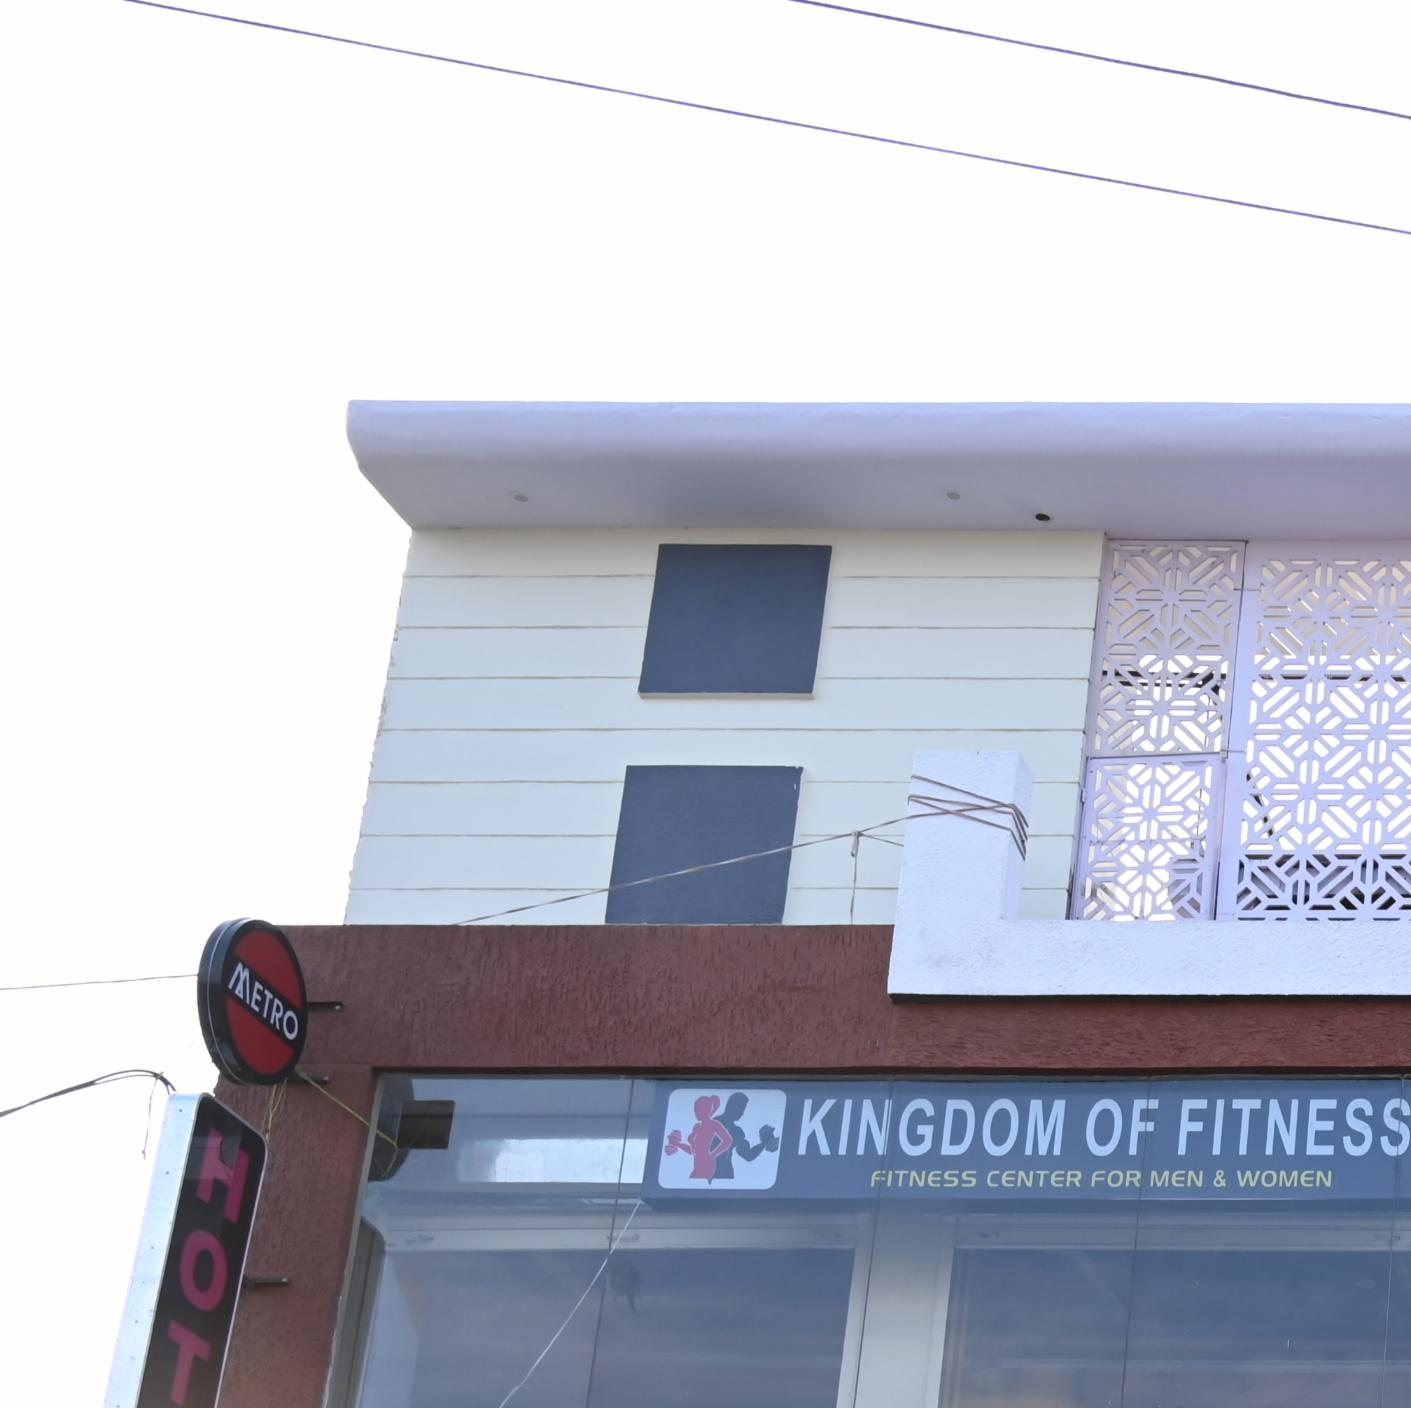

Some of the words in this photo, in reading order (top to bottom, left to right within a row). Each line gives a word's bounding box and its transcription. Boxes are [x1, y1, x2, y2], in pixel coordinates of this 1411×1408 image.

[228, 961, 299, 1042] METRO
[797, 1097, 1066, 1157] KINGDOM
[1085, 1097, 1157, 1157] OF
[1177, 1097, 1411, 1157] FITNESS
[870, 1170, 978, 1189] FITNESS
[986, 1170, 1082, 1189] CENTER
[1091, 1170, 1143, 1188] FOR
[1149, 1170, 1207, 1188] MEN
[1213, 1170, 1227, 1188] &
[1236, 1169, 1333, 1188] WOMEN
